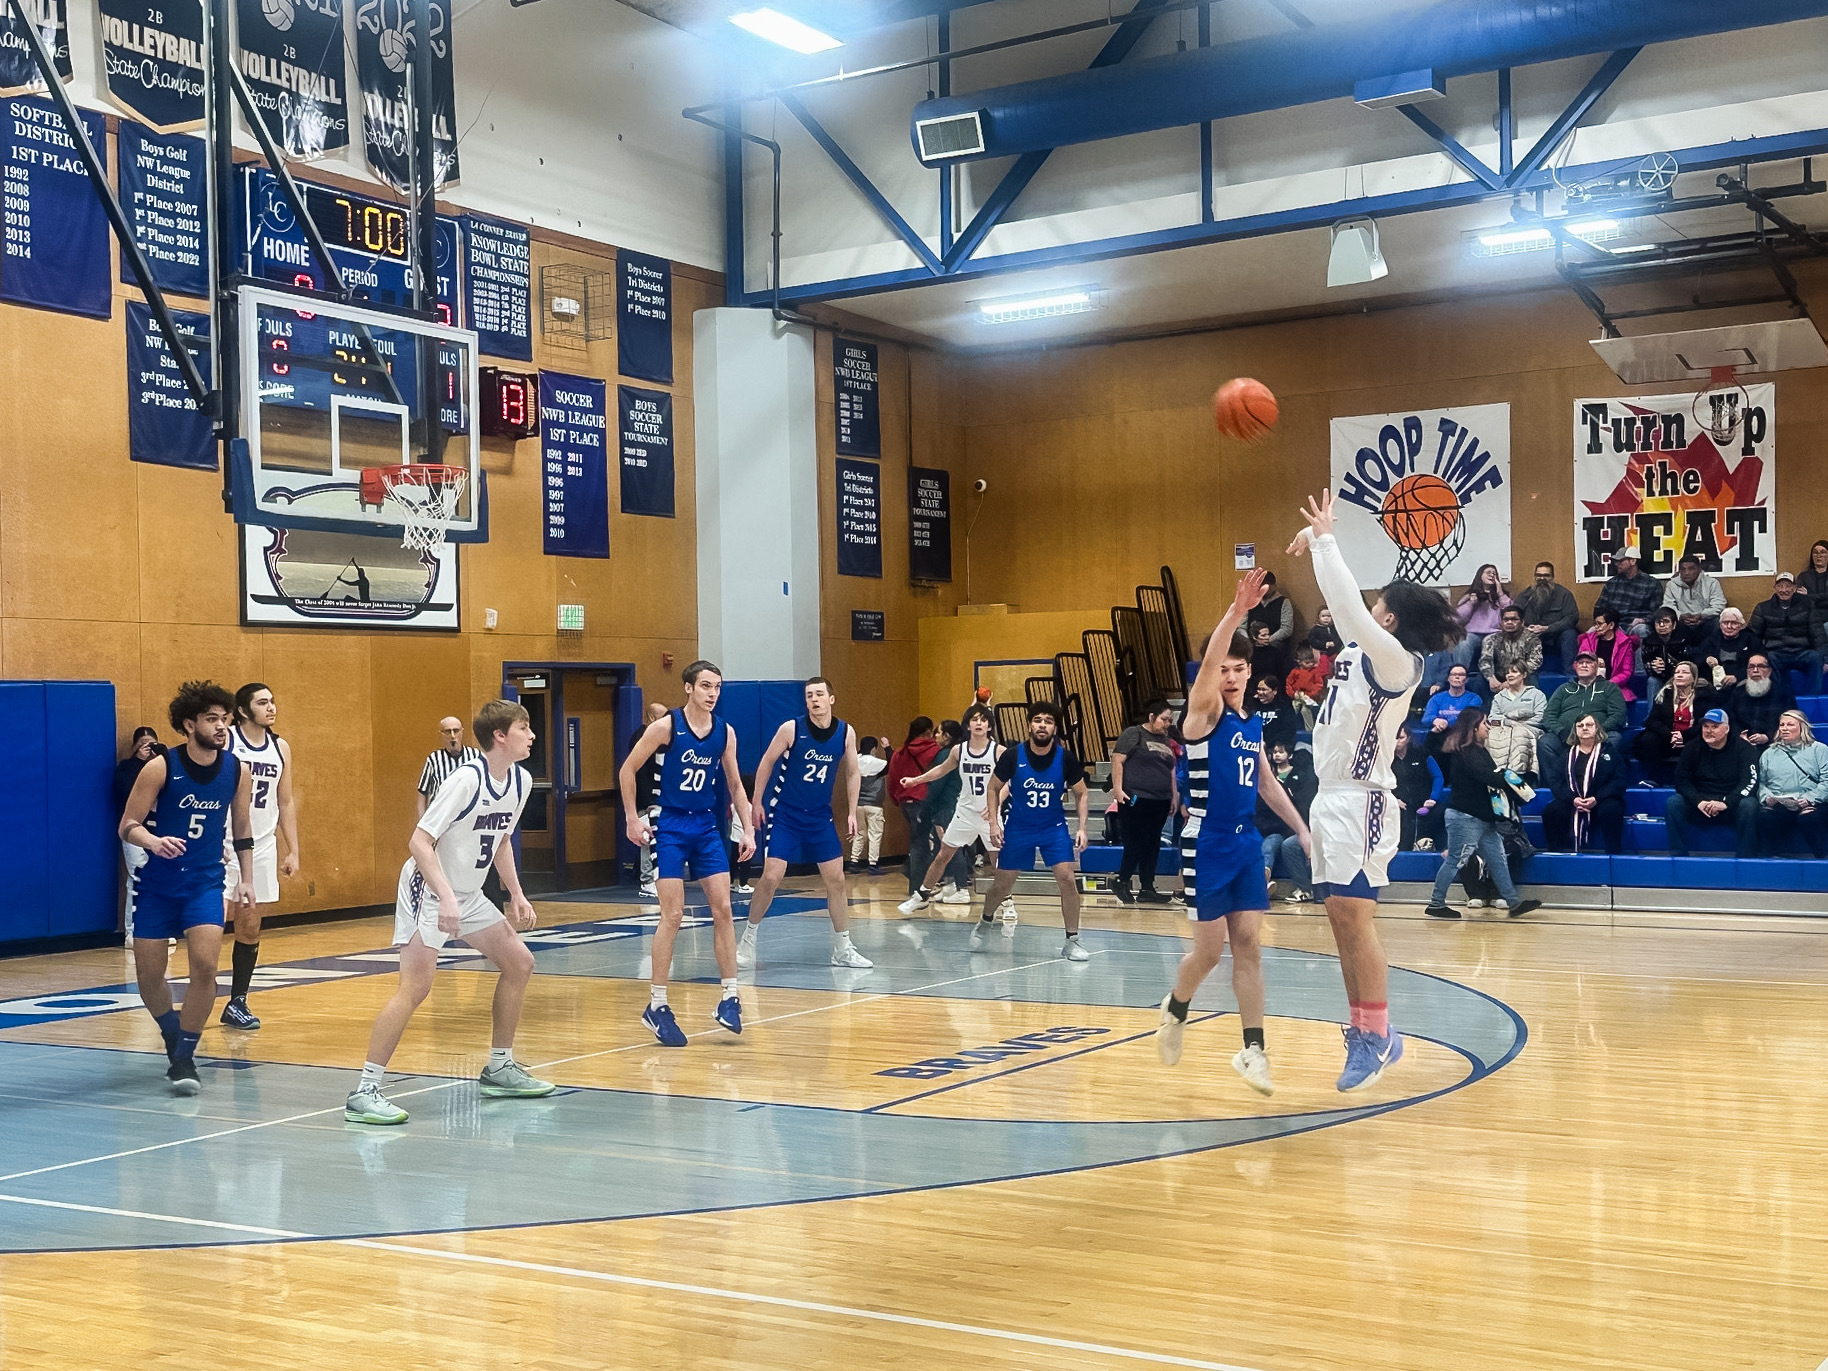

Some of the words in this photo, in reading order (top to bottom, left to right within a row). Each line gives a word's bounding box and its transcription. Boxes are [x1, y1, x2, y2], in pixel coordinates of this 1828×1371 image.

[148, 9, 163, 24] 2B
[283, 44, 297, 59] 2B
[104, 48, 140, 80] State
[241, 48, 342, 105] VOLLEYBALL
[140, 138, 164, 157] Boys
[166, 146, 187, 162] Golf
[11, 146, 39, 164] 1ST
[42, 152, 88, 176] PLAC
[137, 155, 154, 171] NW
[156, 159, 191, 179] League
[4, 166, 29, 181] 1992
[4, 181, 29, 196] 2008
[147, 174, 184, 194] District
[5, 196, 30, 212] 2009
[146, 193, 173, 211] Place
[175, 202, 198, 216] 2007
[5, 211, 30, 227] 2010
[147, 209, 174, 228] Place
[176, 218, 200, 233] 2012
[336, 198, 405, 255] 7:00
[5, 227, 31, 243] 2013
[148, 227, 174, 245] Place
[176, 235, 199, 250] 2014
[6, 242, 31, 259] 2014
[149, 245, 176, 262] Place
[263, 237, 310, 267] HOME
[470, 232, 529, 260] KNOWLEDGE
[471, 248, 498, 268] BOWL
[500, 257, 529, 275] STATE
[342, 267, 378, 287] PERIOD
[471, 266, 529, 287] CHAMPIONSHIPS
[145, 335, 162, 349] NW
[160, 355, 180, 369] Sta
[846, 348, 867, 360] GIRLS
[844, 358, 871, 371] SOCCER
[141, 371, 155, 383] 3rd
[155, 374, 181, 388] Place
[852, 369, 878, 382] LEAGUE
[141, 391, 155, 403] 3rd
[155, 393, 182, 408] Place
[502, 385, 524, 424] 13
[555, 390, 593, 408] SOCCER
[635, 400, 657, 413] BOYS
[542, 407, 565, 423] NWB
[568, 411, 606, 429] LEAGUE
[629, 410, 662, 425] SOCCER
[1581, 403, 1687, 454] Turn
[1709, 393, 1767, 456] Up
[550, 428, 566, 442] 1ST
[570, 430, 600, 447] PLACE
[634, 422, 659, 435] STATE
[624, 432, 669, 446] TOURNAMENT
[1338, 416, 1423, 512] HOOP
[1433, 417, 1504, 507] TIME
[1645, 461, 1701, 497] the
[917, 488, 943, 499] SOCCER
[921, 499, 940, 508] STATE
[913, 508, 947, 518] TOURNAMENT
[1583, 507, 1767, 578] HEAT
[681, 749, 713, 766] Orcas
[804, 749, 833, 762] Orcas
[803, 764, 828, 784] 24
[962, 763, 992, 775] BRAVES
[1237, 756, 1255, 787] 12
[679, 768, 706, 792] 20
[969, 776, 985, 796] 15
[1023, 778, 1055, 789] Orcas
[179, 794, 222, 809] Orcas
[1026, 791, 1050, 808] 33
[188, 814, 207, 839] 5
[473, 812, 513, 831] BRAVES
[475, 835, 495, 869] 3
[870, 1026, 1111, 1079] BRAVES
